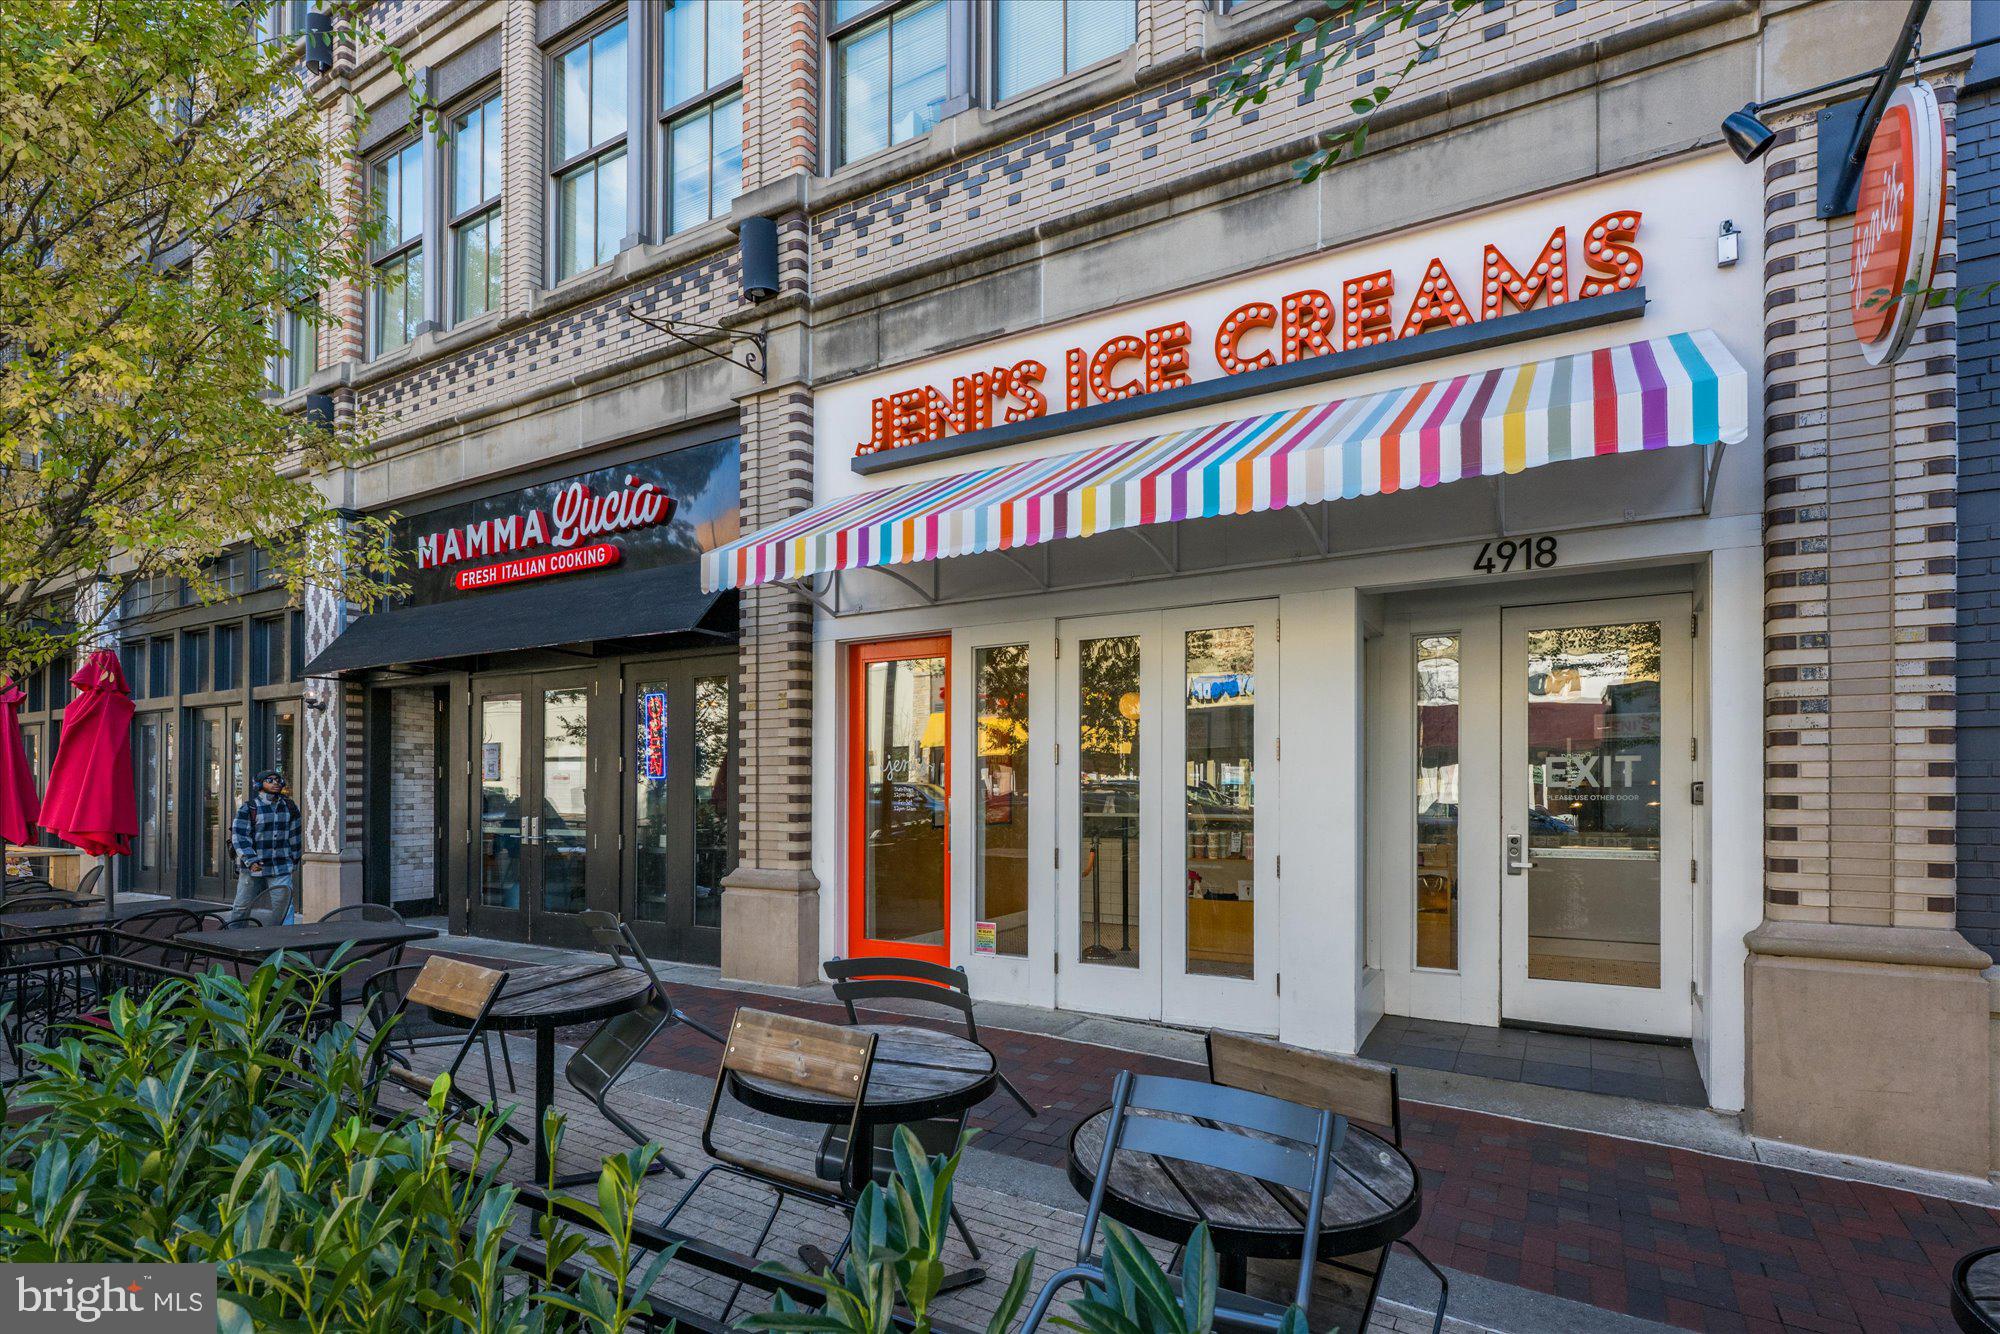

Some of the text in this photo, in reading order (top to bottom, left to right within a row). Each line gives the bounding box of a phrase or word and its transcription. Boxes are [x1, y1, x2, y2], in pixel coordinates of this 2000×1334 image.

[1850, 160, 1905, 311] jeni's
[856, 210, 1644, 456] JENI'S ICE CREAMS
[418, 474, 665, 569] MAMMA Lucia
[1474, 536, 1557, 574] 4918
[462, 547, 606, 586] FRESH ITALIAN COOKING
[647, 697, 663, 775] OPEN
[1546, 755, 1641, 787] EXIT
